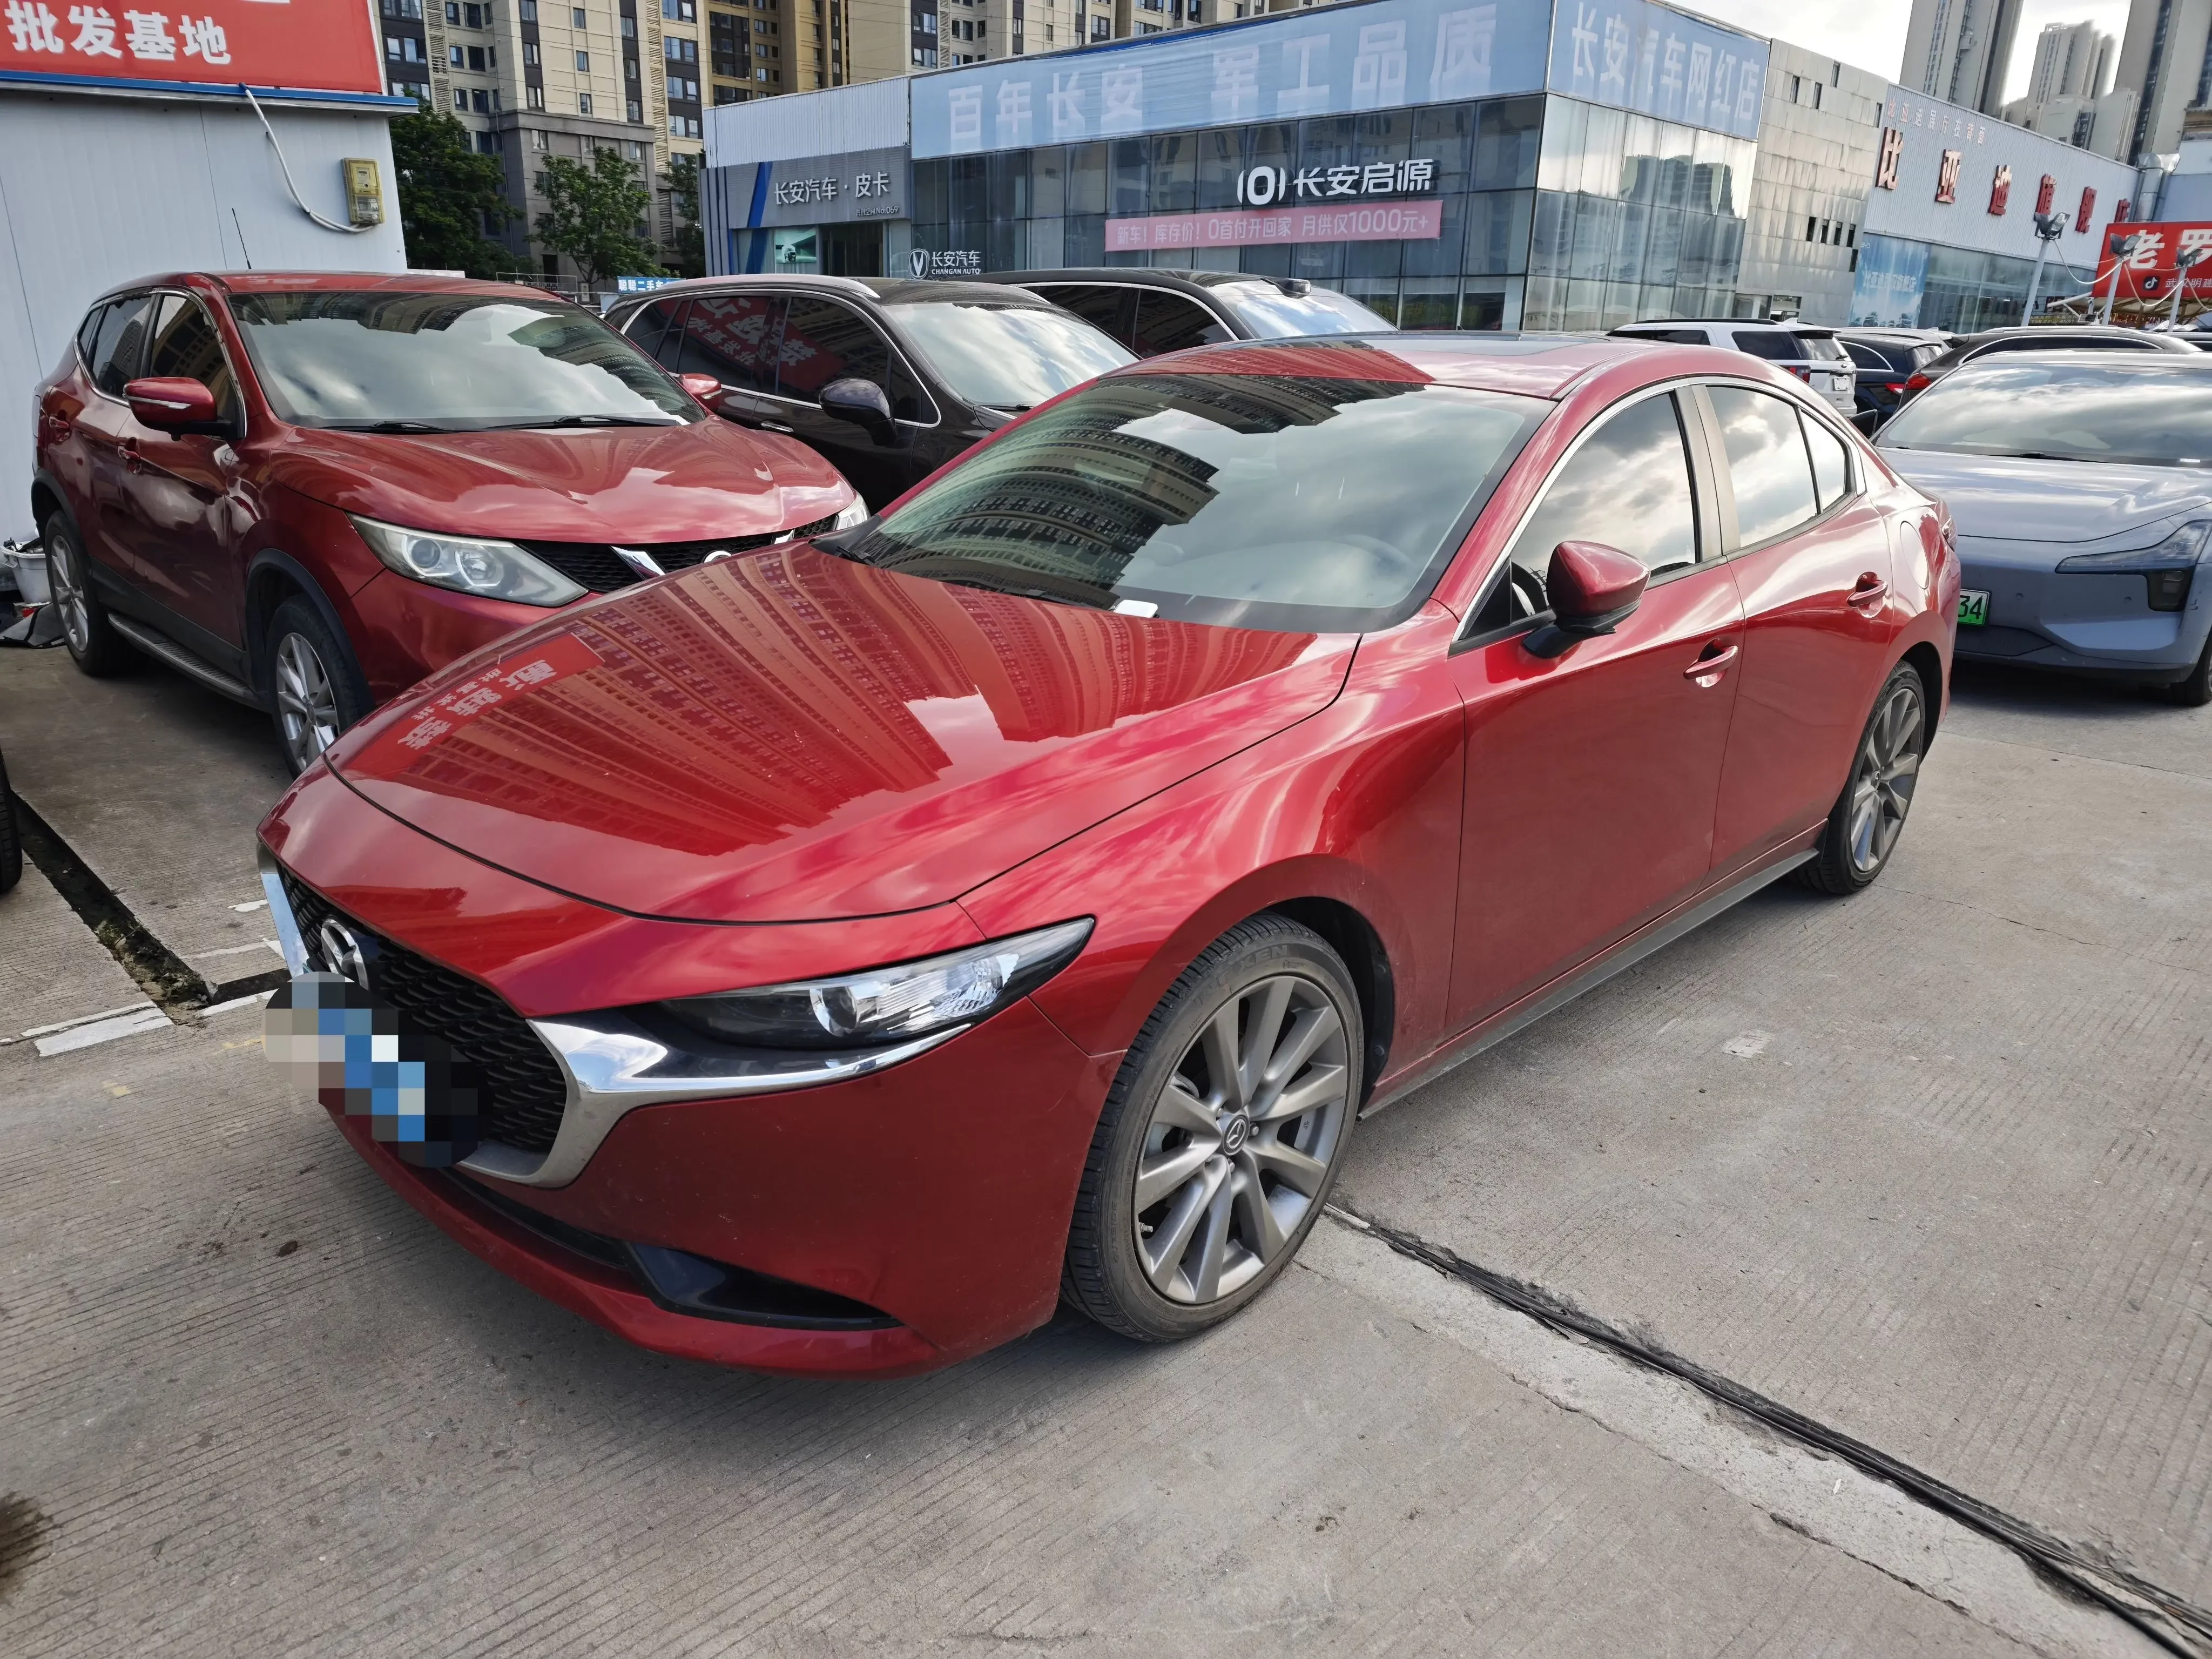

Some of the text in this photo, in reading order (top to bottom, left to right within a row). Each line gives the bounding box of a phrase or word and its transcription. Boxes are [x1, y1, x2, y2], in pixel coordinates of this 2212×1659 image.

[4, 0, 231, 65] 批发基地
[948, 3, 1498, 141] 百年长安 军工品质
[1294, 158, 1434, 197] 长安启源
[932, 250, 981, 267] 长安汽车
